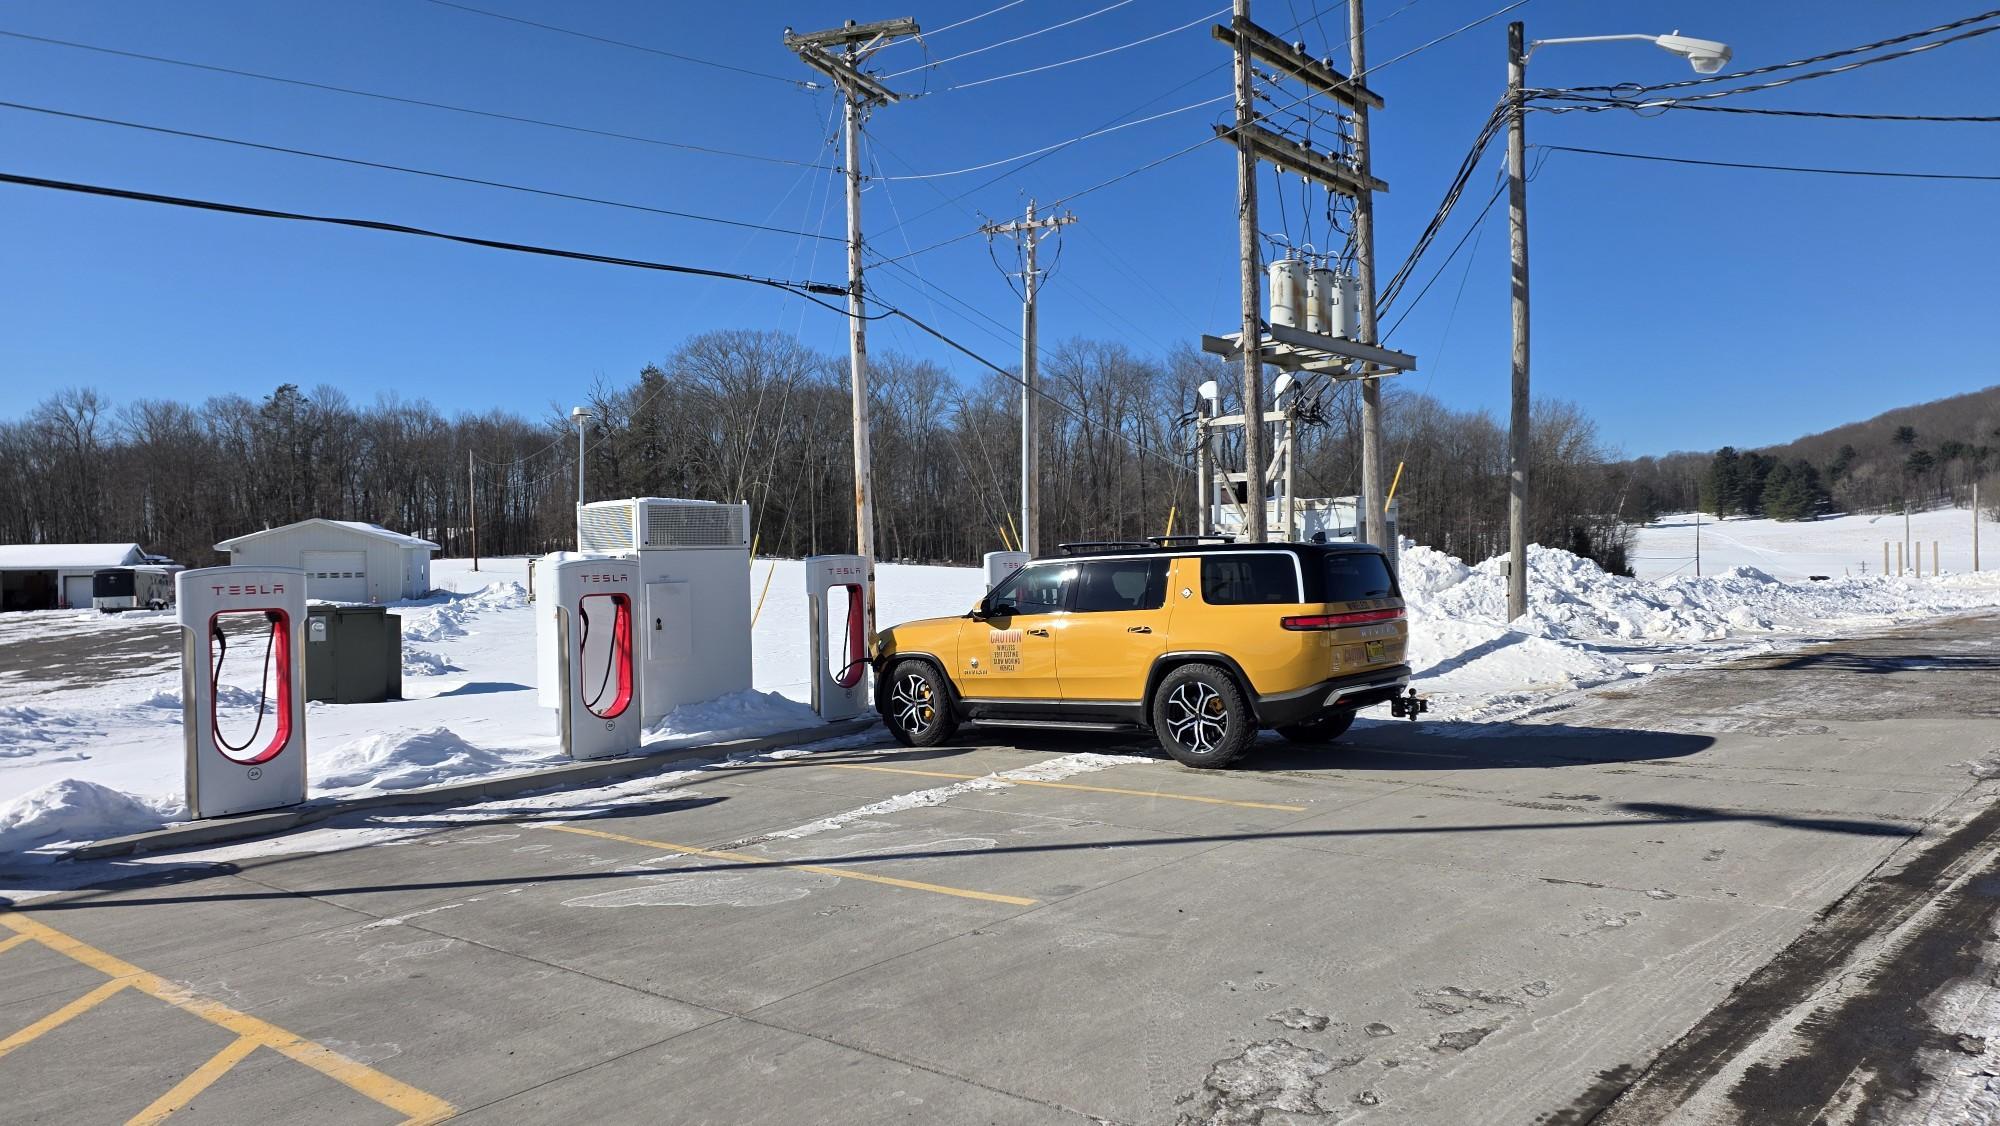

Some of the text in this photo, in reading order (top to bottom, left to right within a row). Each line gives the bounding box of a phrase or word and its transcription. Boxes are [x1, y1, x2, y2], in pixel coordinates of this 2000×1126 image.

[827, 567, 862, 576] TESLA
[580, 574, 628, 583] TESLA
[211, 584, 284, 596] TESLA
[990, 631, 1022, 644] CAUTION
